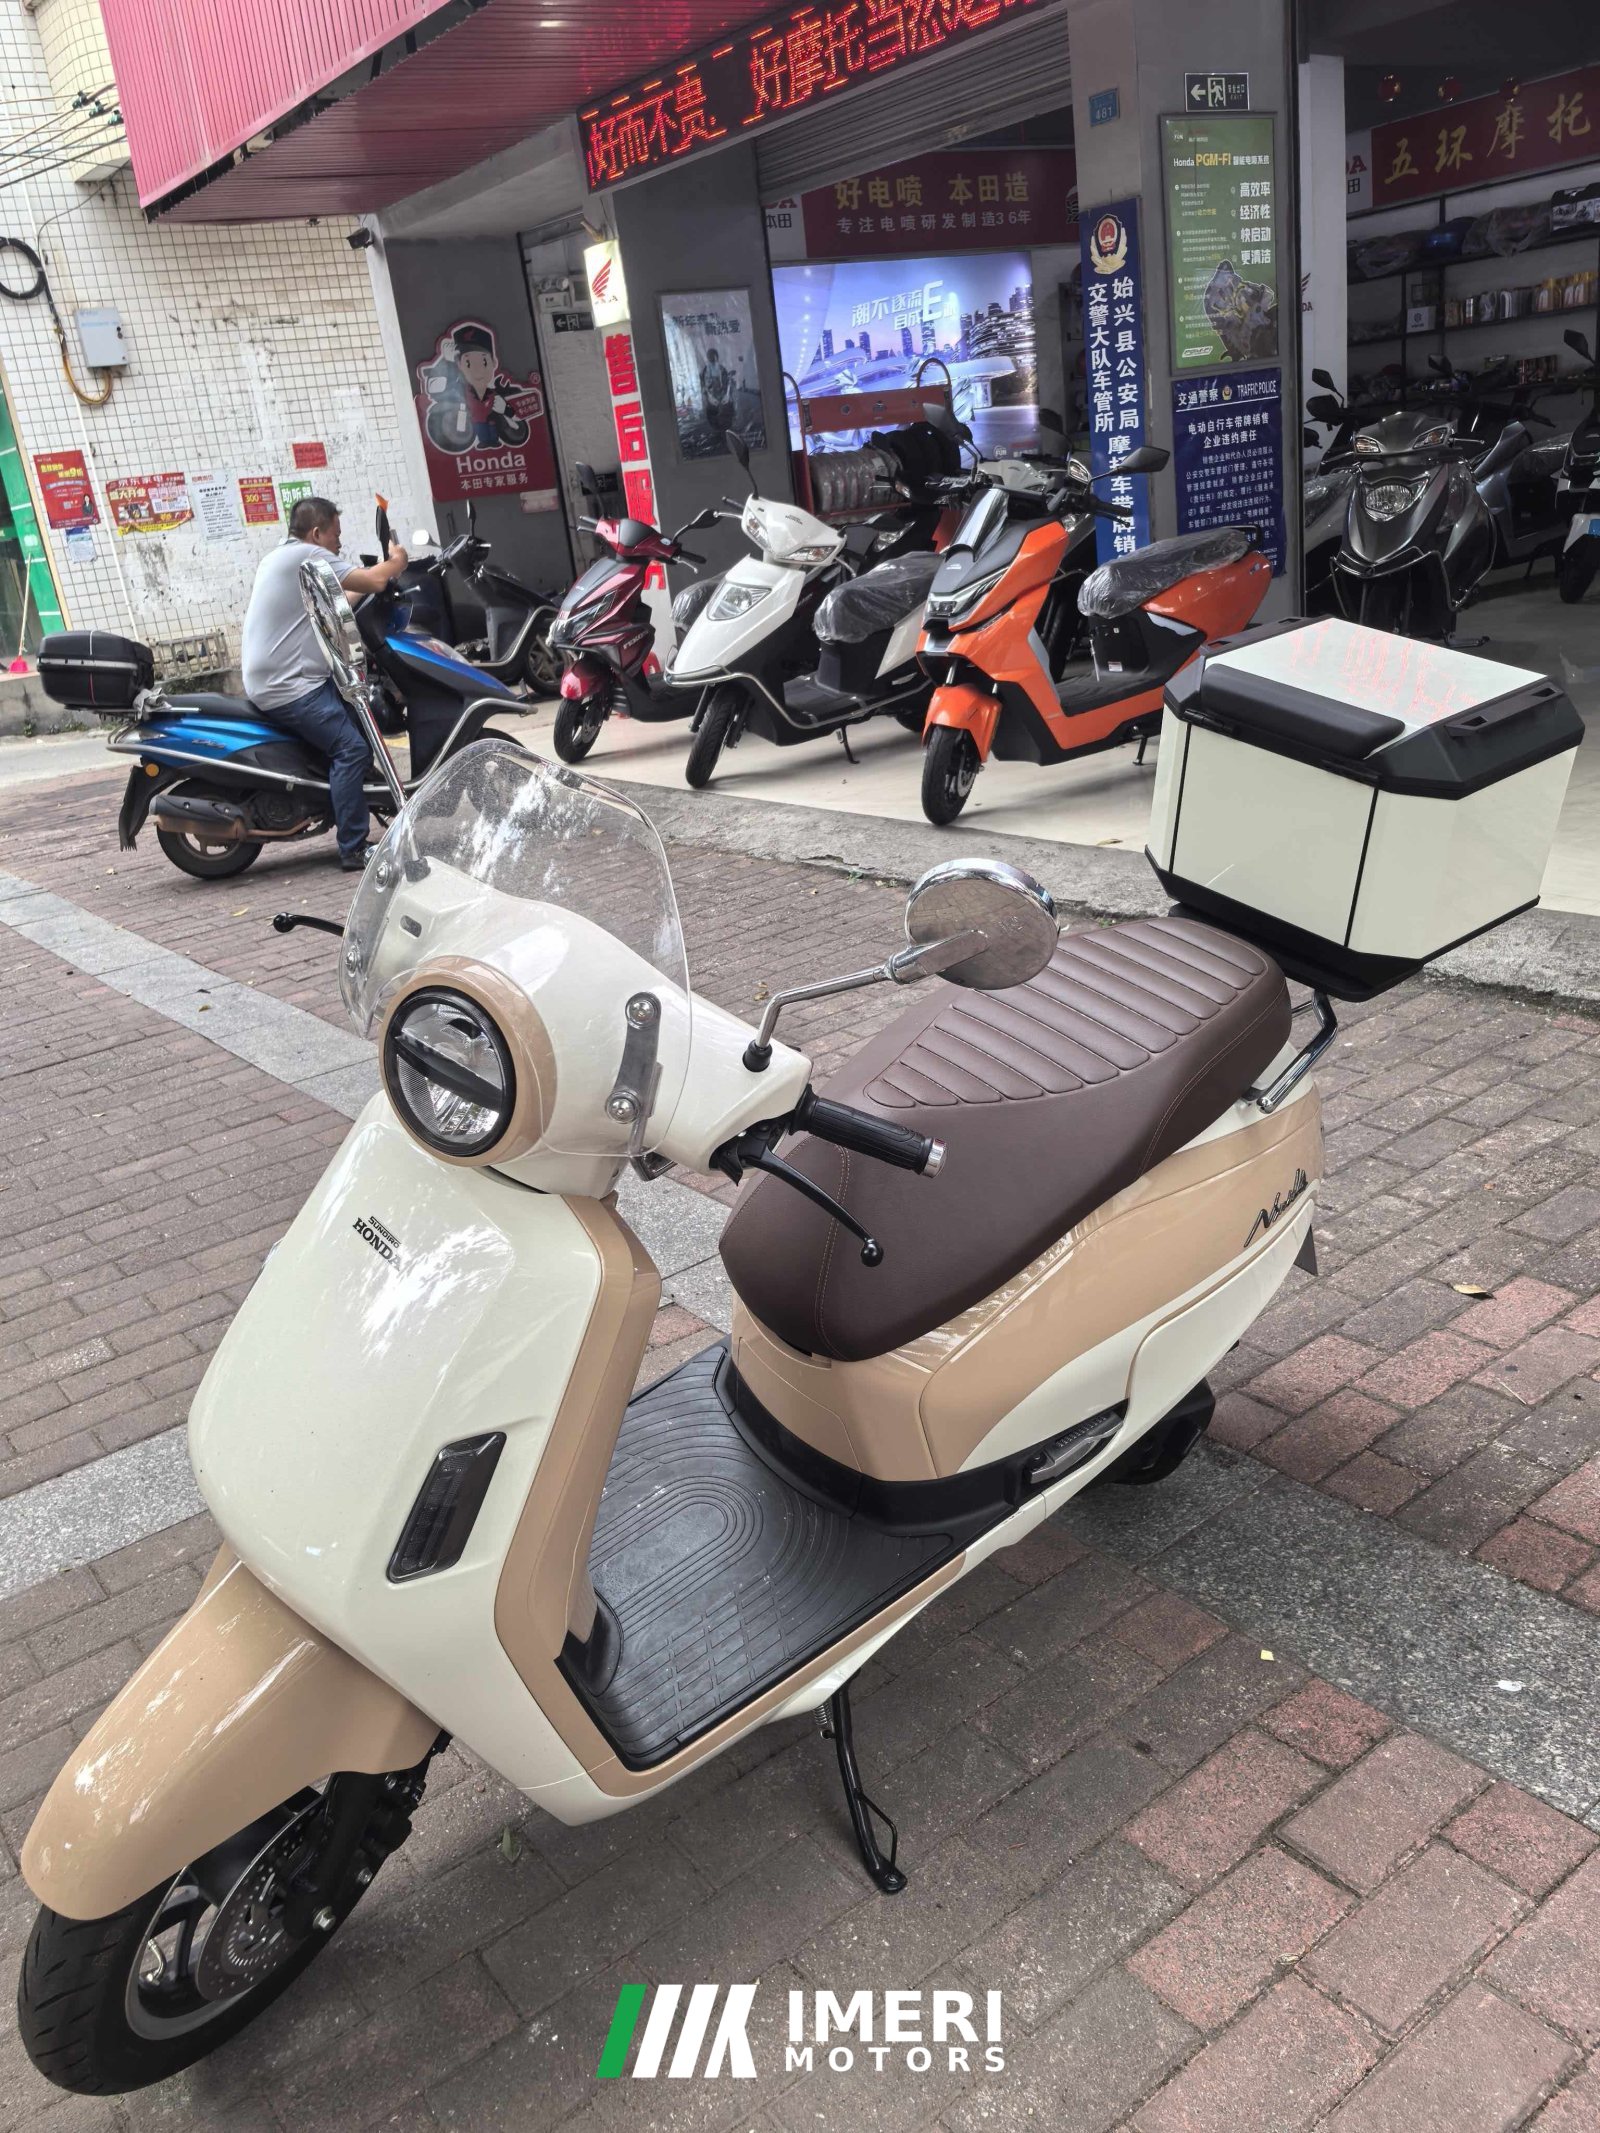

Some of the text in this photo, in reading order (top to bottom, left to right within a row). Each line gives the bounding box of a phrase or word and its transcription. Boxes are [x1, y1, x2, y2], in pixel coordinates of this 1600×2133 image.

[1095, 107, 1113, 120] 481
[1173, 157, 1195, 167] Honda
[1195, 152, 1231, 167] PGM-FI
[834, 170, 1030, 210] 好电喷 本田造
[1240, 181, 1271, 198] 高效率
[1240, 204, 1271, 220] 经济性
[1240, 226, 1271, 243] 快启动
[1241, 249, 1271, 265] 更清洁
[1088, 283, 1115, 433] 交警大队车管所
[1111, 276, 1140, 430] 始兴县公安局
[1178, 380, 1277, 406] 交通警察 TRAFFIC POLICE
[1188, 412, 1270, 435] 电动自行车带牌销售
[1203, 430, 1257, 449] 企业违约责任
[455, 451, 527, 475] Honda
[460, 472, 529, 490] 本田专家服务
[368, 1215, 401, 1249] SUNDIRO
[352, 1216, 401, 1272] HONDA
